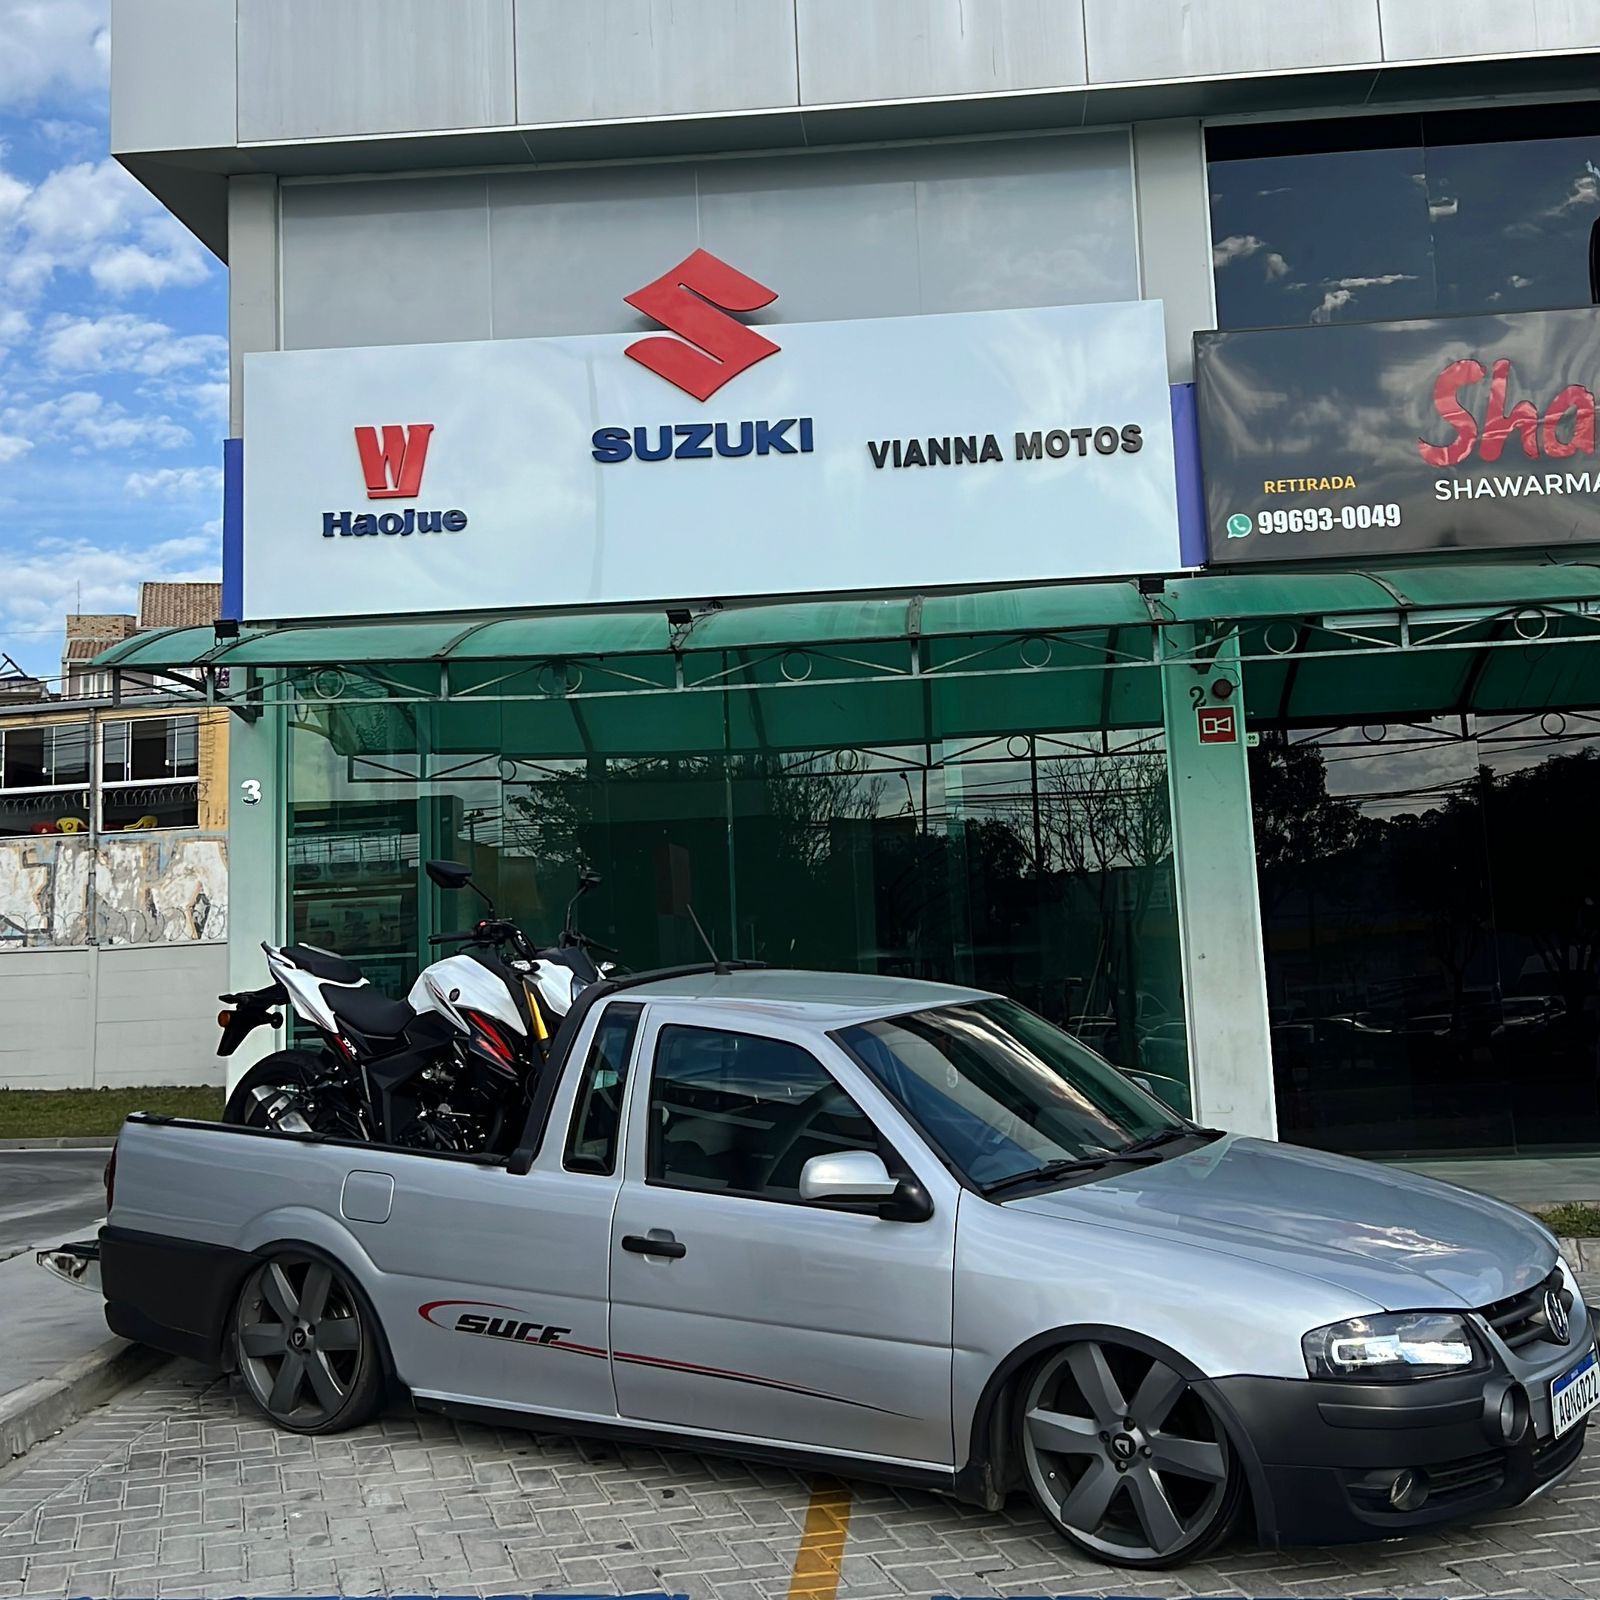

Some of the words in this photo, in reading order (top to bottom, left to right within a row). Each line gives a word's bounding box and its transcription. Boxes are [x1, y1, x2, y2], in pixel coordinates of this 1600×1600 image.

[591, 417, 814, 463] SUZUKI
[867, 434, 1004, 469] VIANNA
[1014, 424, 1143, 461] MOTOS
[1263, 475, 1357, 494] RETIRADA
[322, 508, 468, 538] Haojue
[1257, 503, 1402, 535] 99693-0049
[1189, 686, 1207, 711] 2
[240, 779, 262, 806] 3
